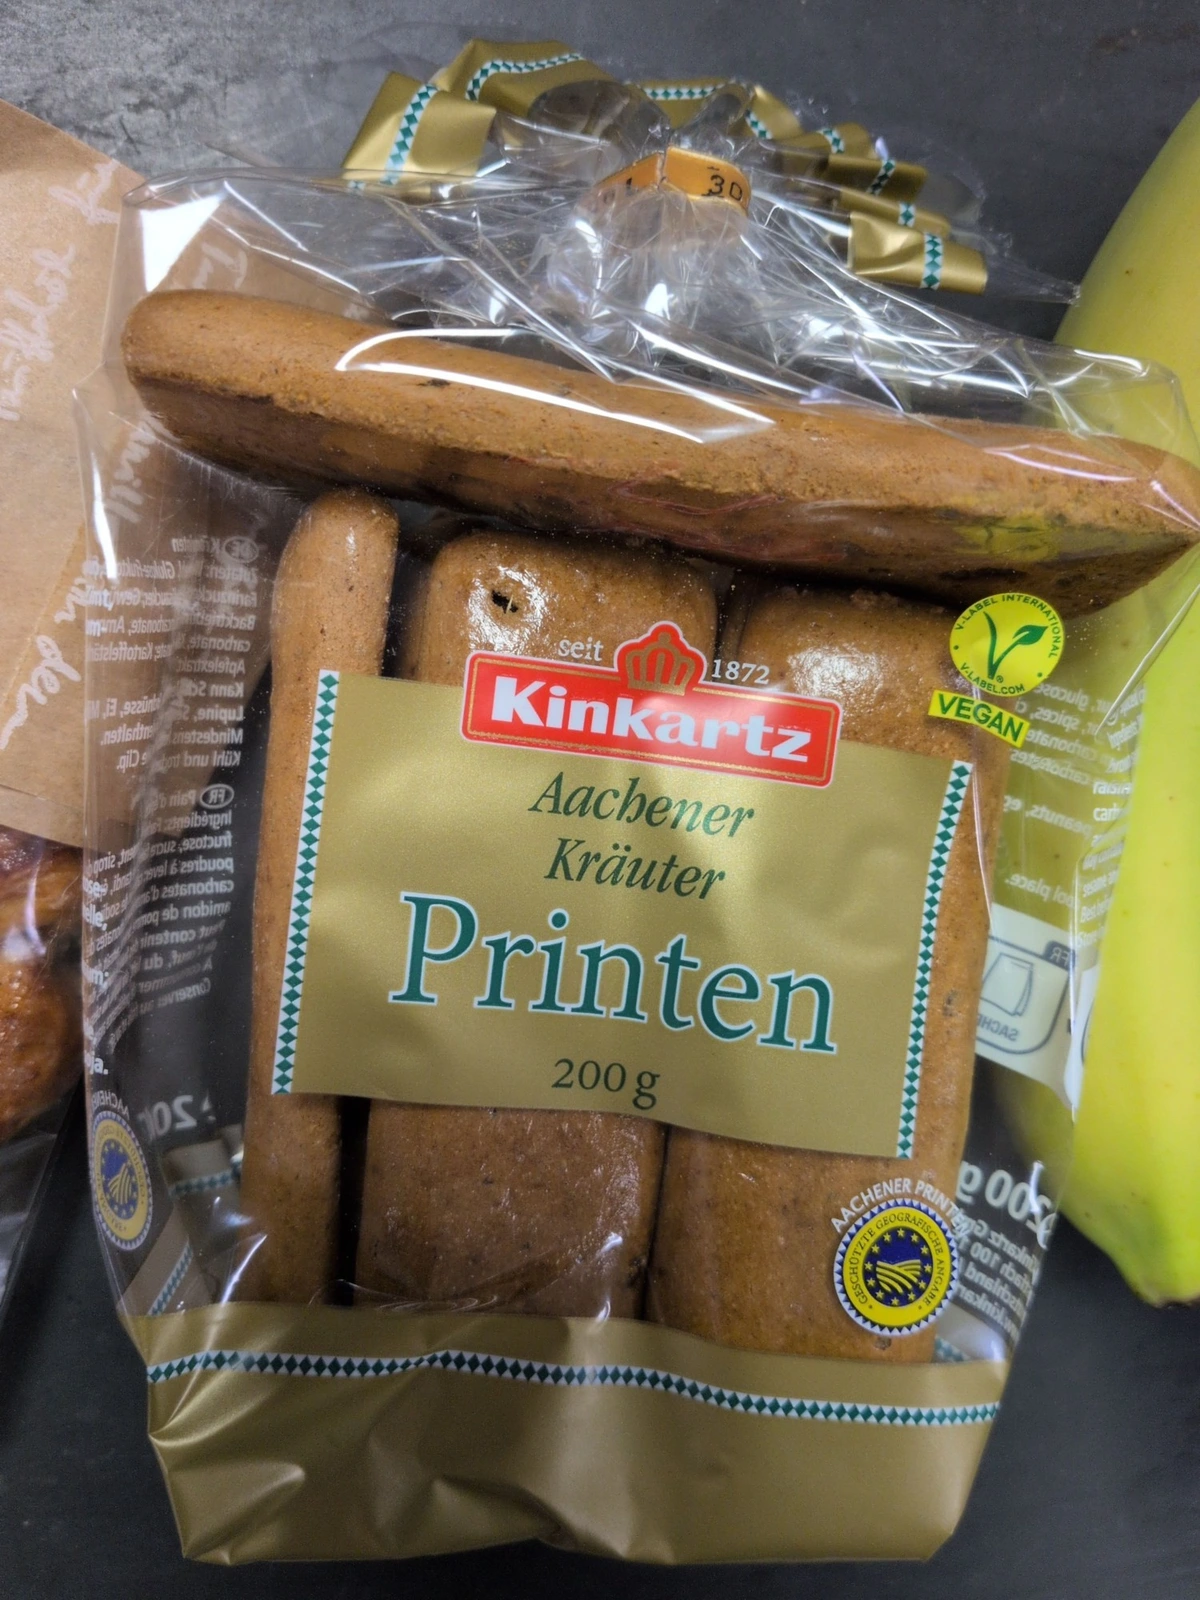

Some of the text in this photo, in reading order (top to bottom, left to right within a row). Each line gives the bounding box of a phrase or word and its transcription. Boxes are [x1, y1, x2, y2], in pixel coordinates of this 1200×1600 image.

[954, 594, 1061, 658] V-LABEL INTERNATIONAL
[558, 637, 770, 685] seit 1872
[960, 662, 1025, 694] V-LABEL.COM
[491, 675, 812, 763] Kinkartz
[938, 693, 1024, 742] VEGAN
[527, 770, 755, 838] Aachener
[544, 838, 726, 900] Kräuter
[388, 891, 838, 1056] Printen
[551, 1058, 661, 1110] 200 g
[831, 1178, 912, 1234] AACHENER
[849, 1228, 876, 1305] GESCHÜTZTE
[875, 1212, 943, 1255] GEOGRAFISCHE
[924, 1259, 945, 1306] ANGABE
